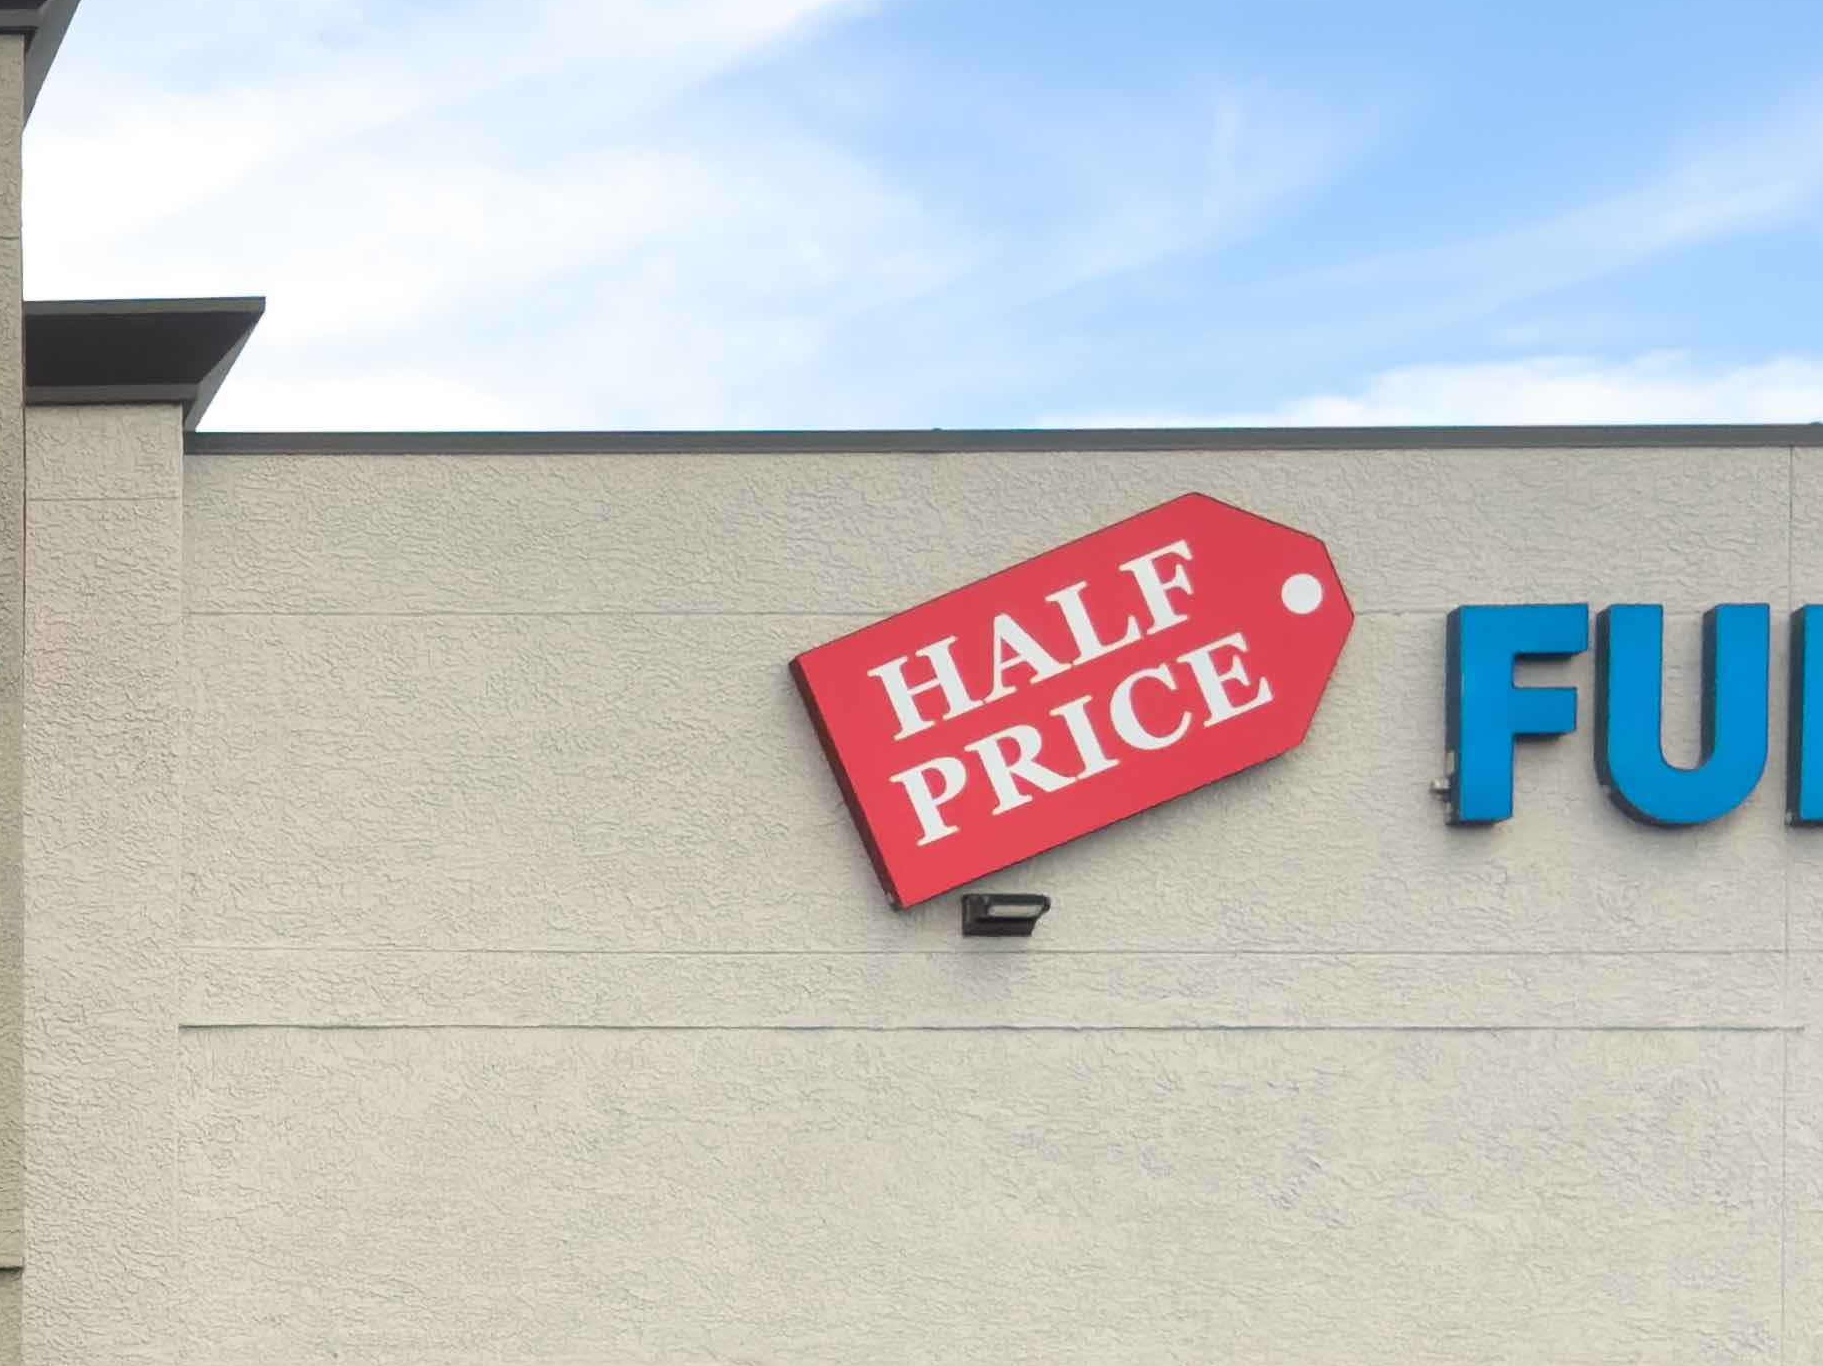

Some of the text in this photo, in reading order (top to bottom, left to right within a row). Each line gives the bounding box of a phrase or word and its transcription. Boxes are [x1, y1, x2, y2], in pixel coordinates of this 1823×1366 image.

[868, 539, 1195, 740] HALF
[890, 631, 1274, 846] PRICE
[1445, 603, 1823, 827] FU
